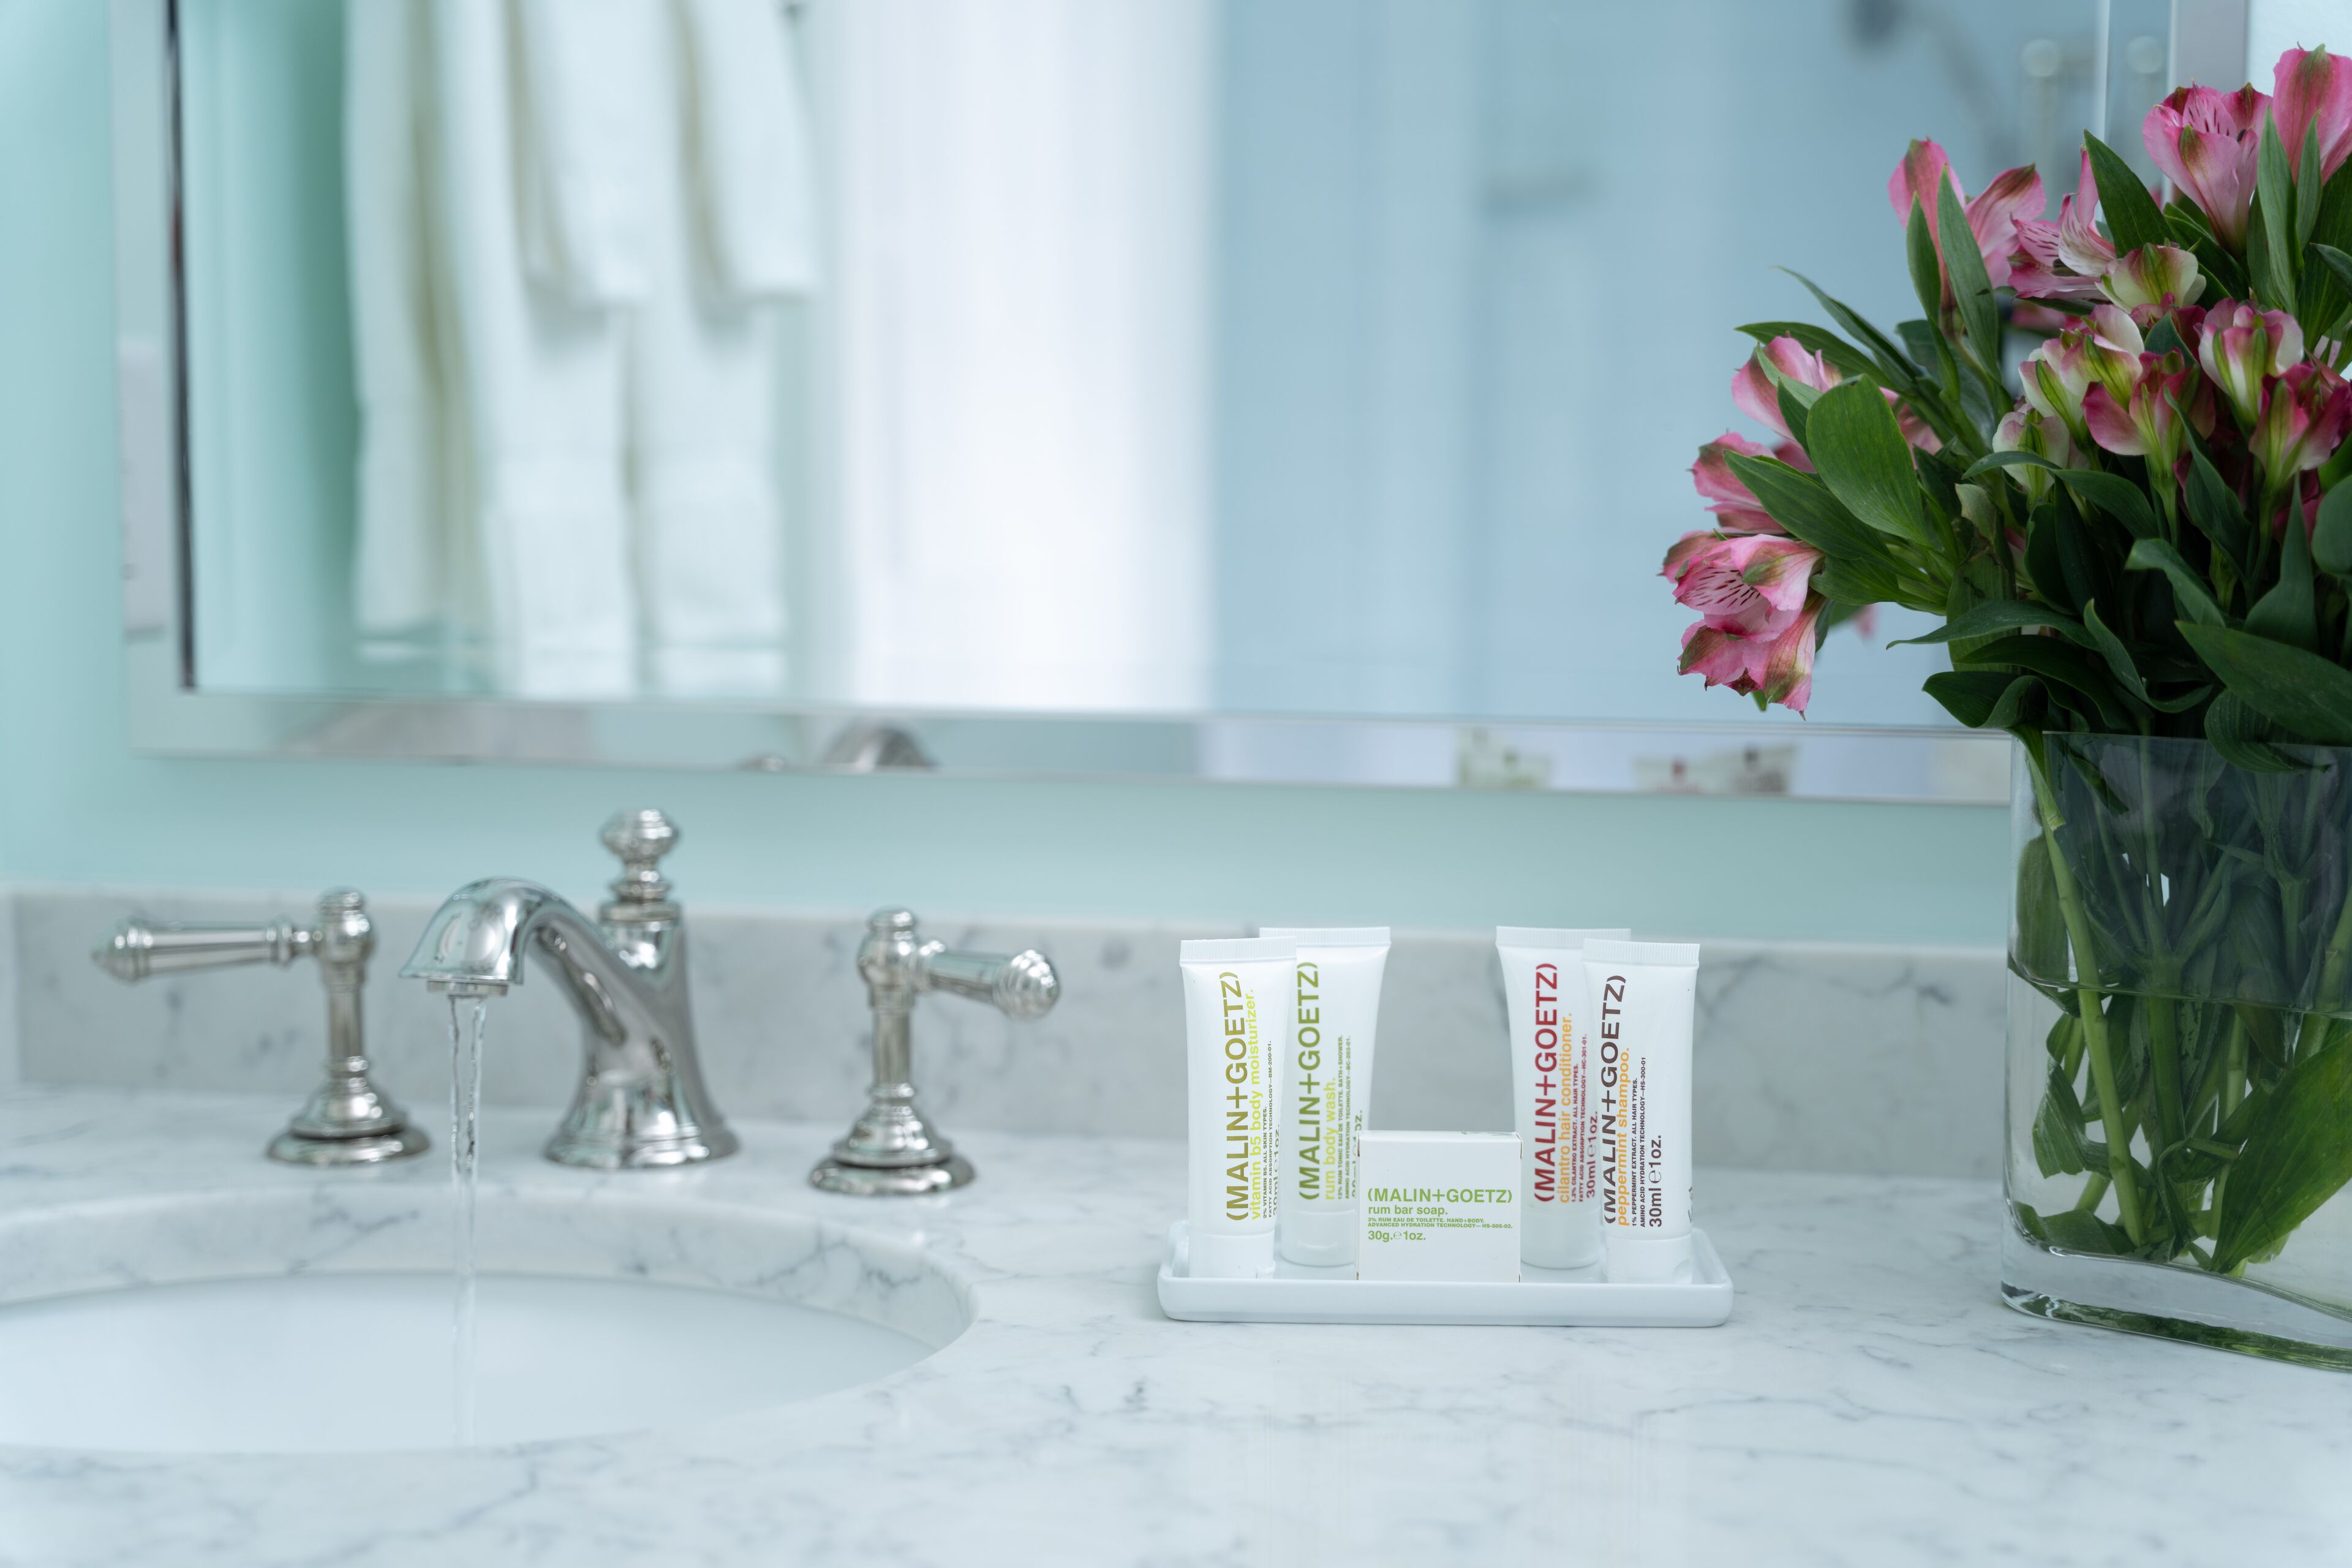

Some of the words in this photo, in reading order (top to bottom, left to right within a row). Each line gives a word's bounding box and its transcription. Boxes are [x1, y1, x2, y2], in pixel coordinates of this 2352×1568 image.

[1245, 989, 1260, 1084] moisturizer.
[1559, 1013, 1572, 1106] conditioner.
[1219, 972, 1248, 1221] (MALIN+GOETZ)
[1297, 962, 1320, 1200] (MALIN+GOETZ)
[1324, 1078, 1335, 1121] wash.
[1534, 963, 1557, 1202] (MALIN+GOETZ)
[1601, 975, 1626, 1224] (MALIN+GOETZ)
[1617, 1047, 1630, 1127] shampoo.
[1250, 1091, 1263, 1130] body
[1558, 1111, 1570, 1140] hair
[1250, 1136, 1261, 1155] b5
[1323, 1127, 1338, 1165] body
[1250, 1161, 1261, 1220] vitamin
[1325, 1170, 1335, 1200] rum
[1368, 1188, 1512, 1203] (MALIN+GOETZ)
[1558, 1146, 1570, 1203] cilantro
[1616, 1133, 1629, 1226] peppermint
[1263, 1208, 1267, 1219] 2%
[1395, 1205, 1413, 1214] bar
[1417, 1207, 1448, 1216] soap.
[1632, 1216, 1637, 1226] 1%
